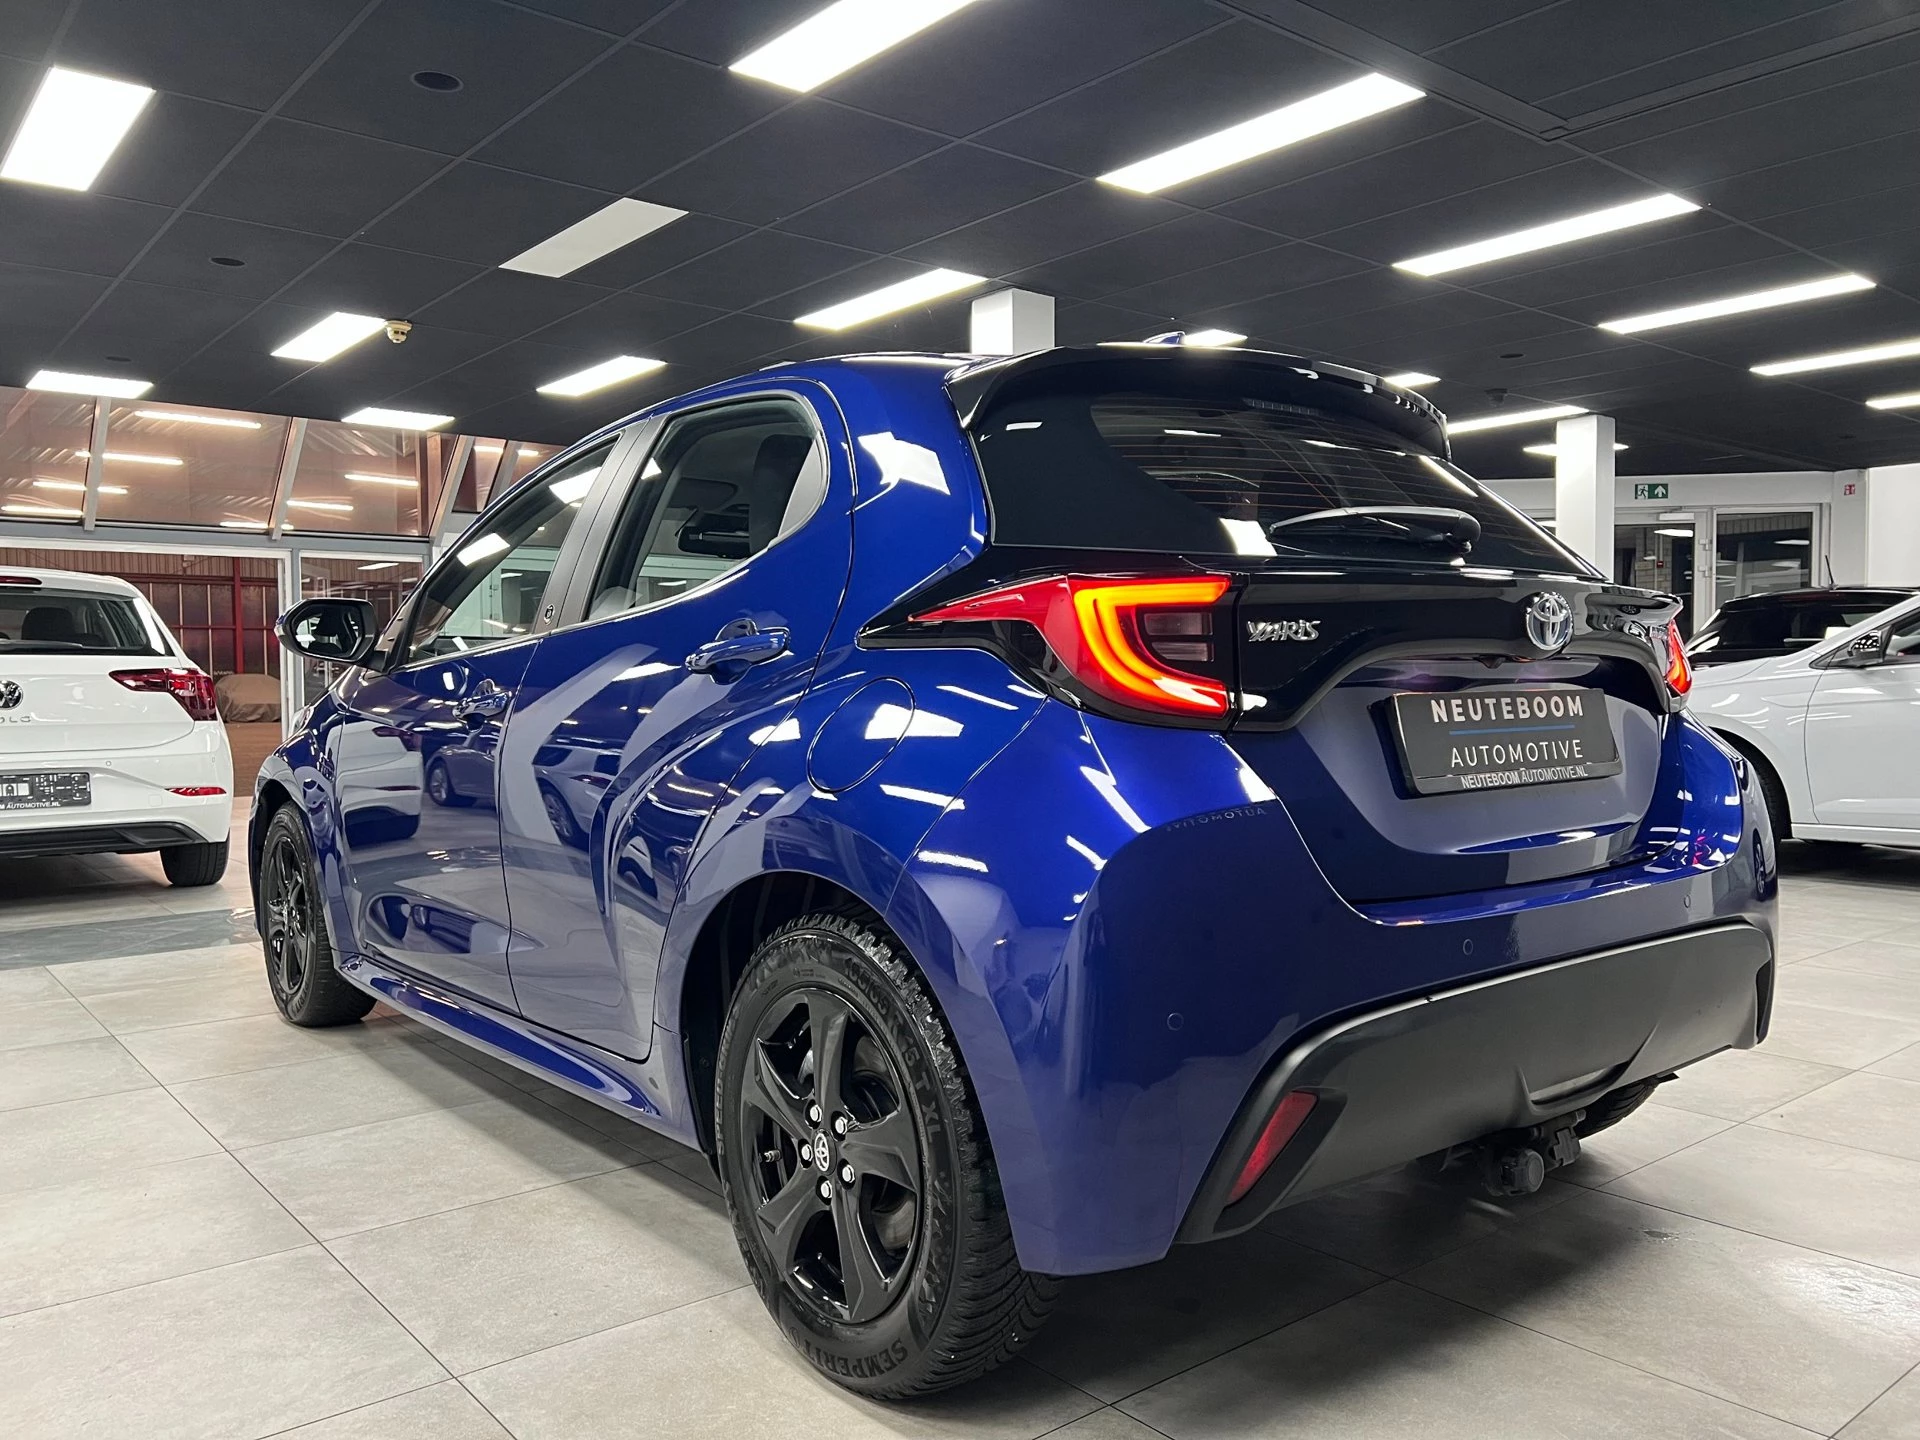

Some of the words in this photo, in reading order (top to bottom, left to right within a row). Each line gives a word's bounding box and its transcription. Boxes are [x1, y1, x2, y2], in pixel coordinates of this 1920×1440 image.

[1246, 619, 1321, 642] YARIS
[1430, 695, 1584, 723] NEUTEBOOM
[1451, 739, 1584, 768] AUTOMOTIVE
[1460, 770, 1520, 789] NEUTEBOOM
[1521, 764, 1589, 784] AUTOMOTIVE.NL
[803, 1337, 909, 1379] SEMPERIT
